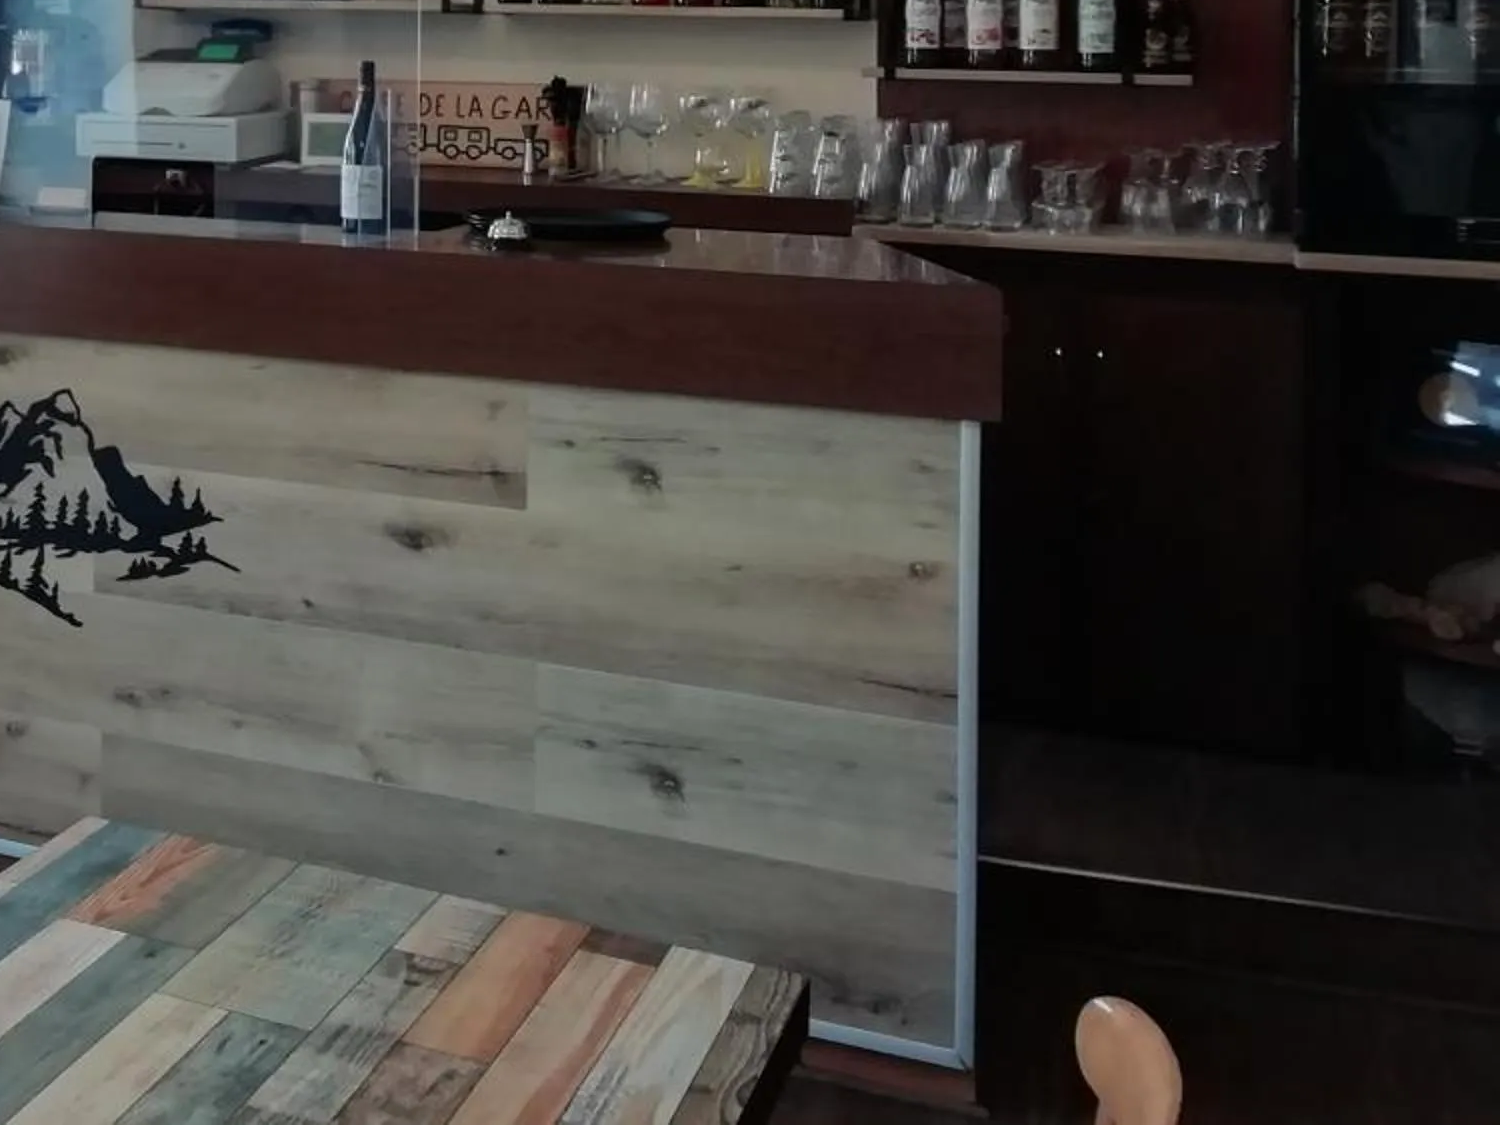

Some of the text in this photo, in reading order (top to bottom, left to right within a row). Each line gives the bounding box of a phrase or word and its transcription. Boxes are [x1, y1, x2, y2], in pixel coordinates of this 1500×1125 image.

[419, 92, 445, 117] DE
[455, 93, 484, 120] LA
[491, 93, 553, 121] GAR
